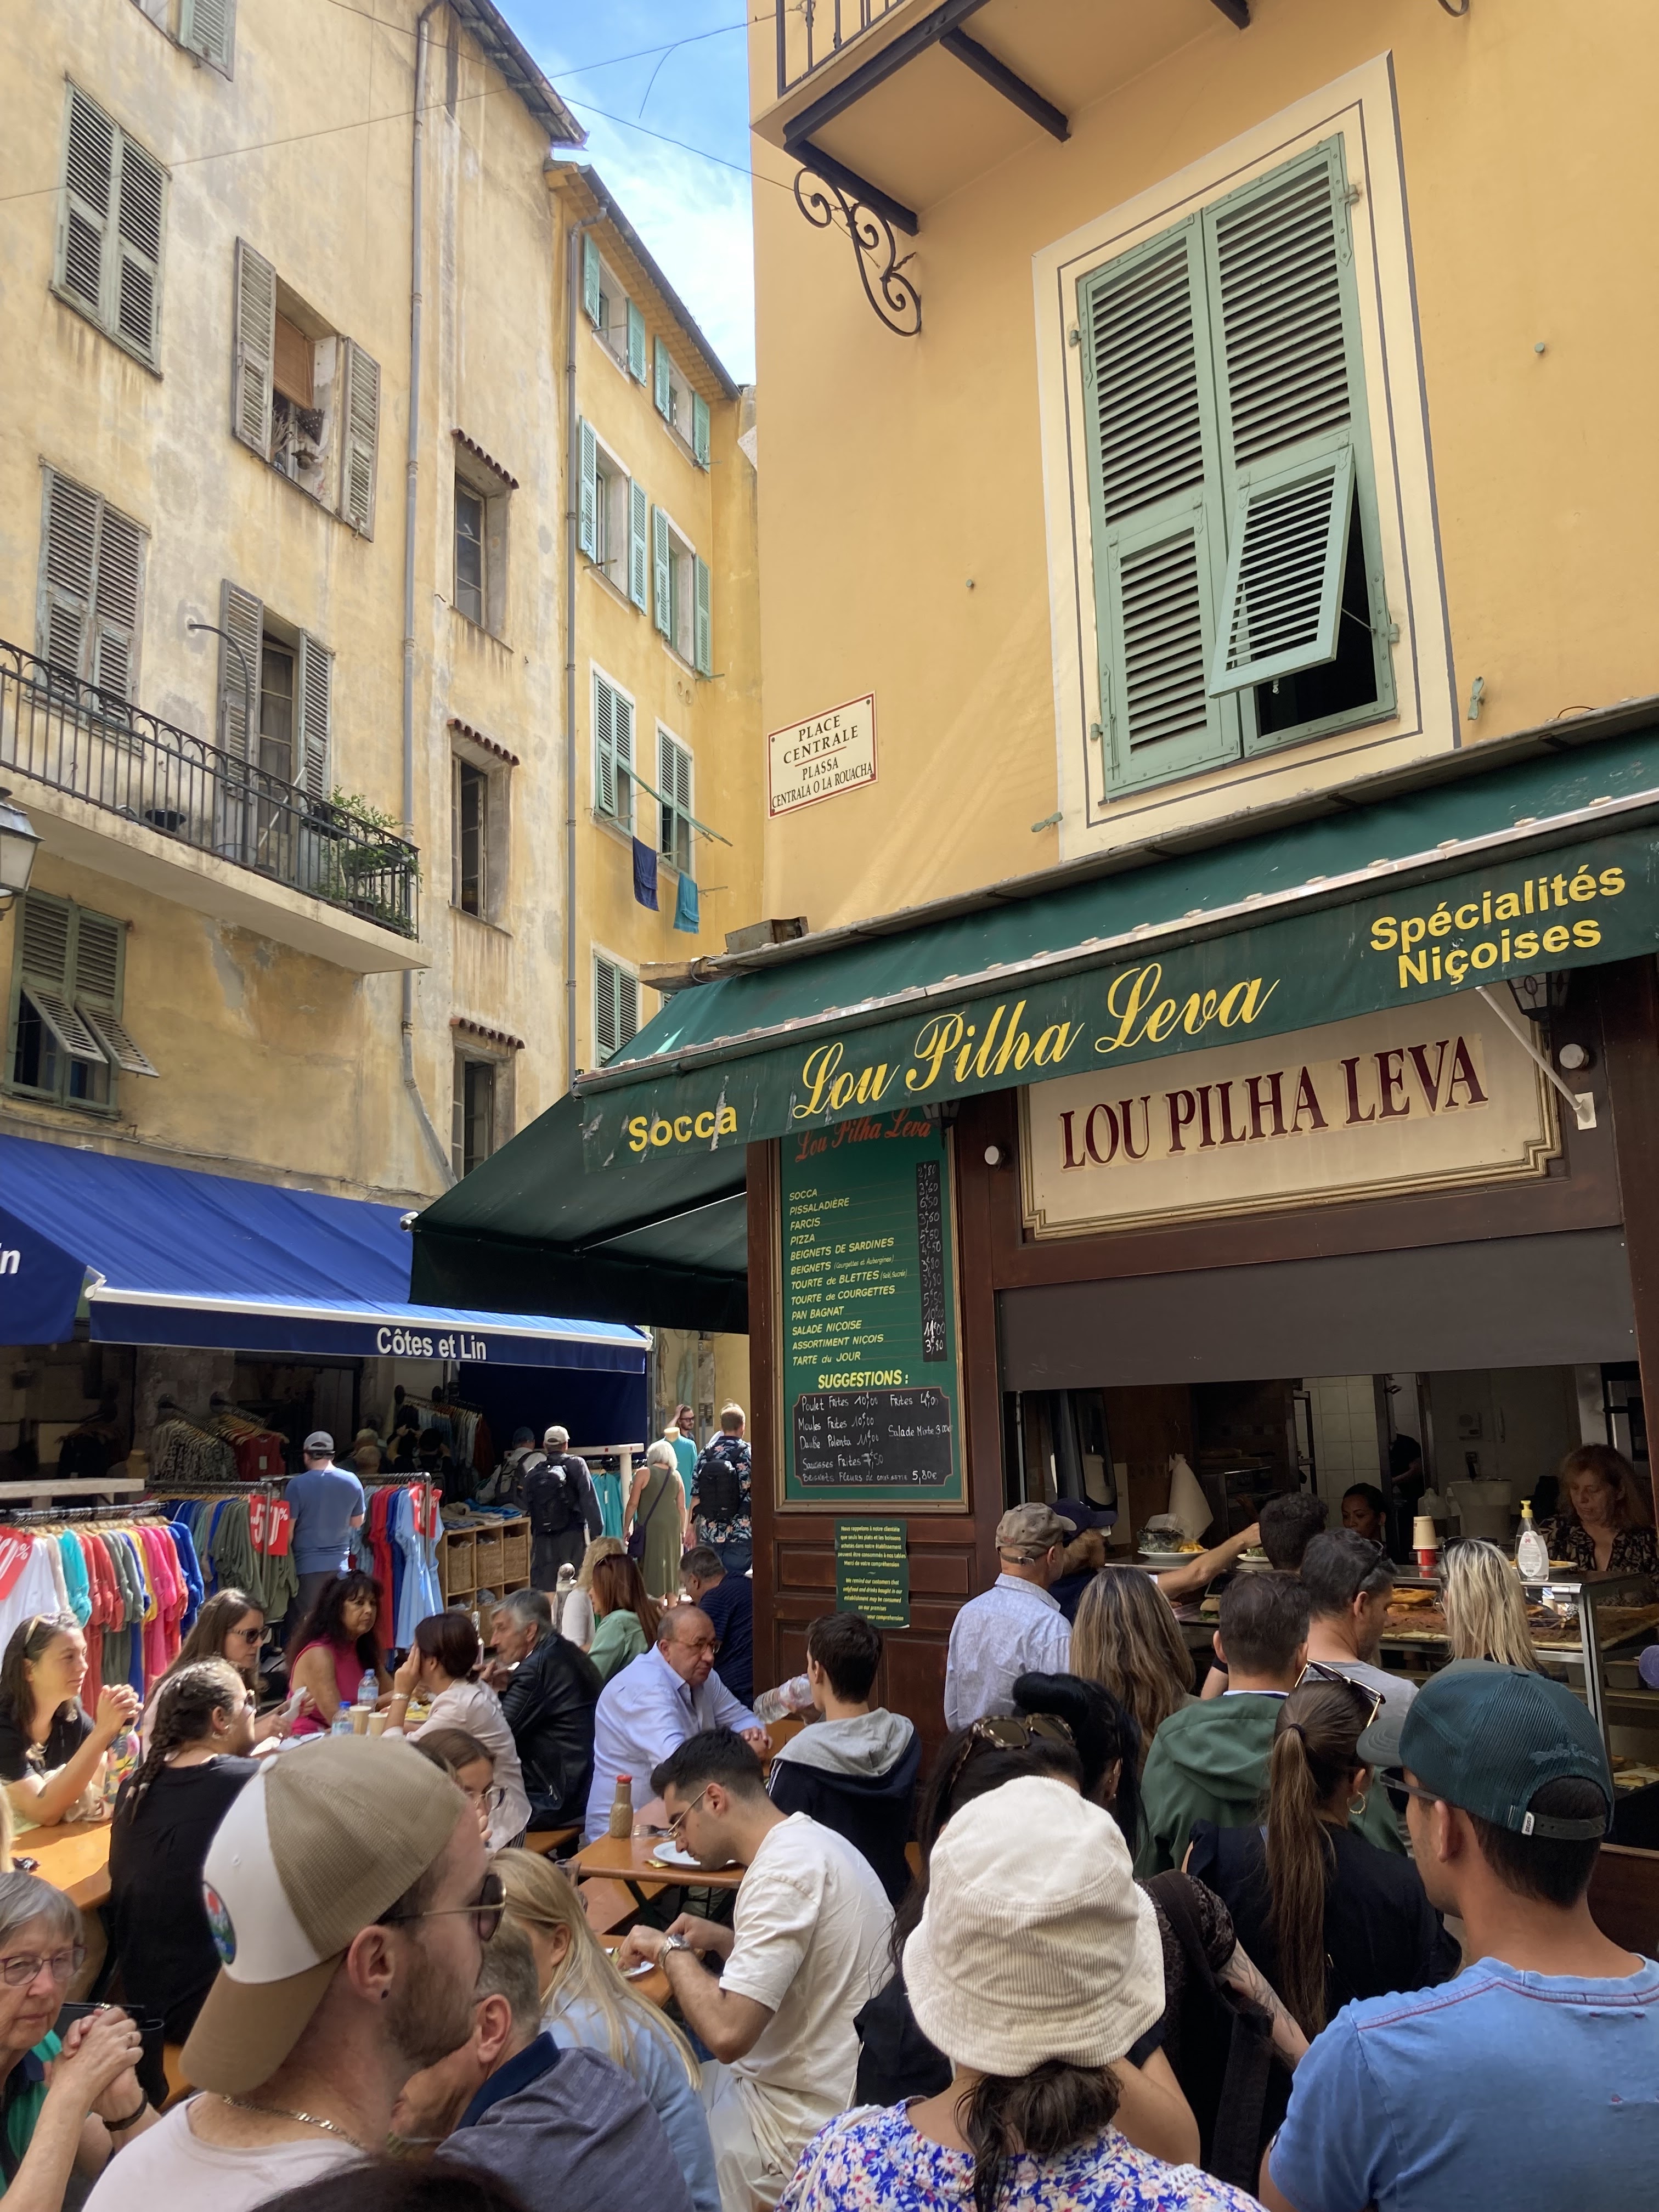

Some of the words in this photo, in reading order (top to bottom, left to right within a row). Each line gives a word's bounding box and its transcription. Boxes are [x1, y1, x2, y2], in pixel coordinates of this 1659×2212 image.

[798, 715, 840, 742] PLACE
[783, 725, 858, 764] CENTRALE
[803, 757, 838, 780] PLASSA
[772, 785, 811, 808] CENTRALA
[814, 781, 819, 793] O
[822, 777, 832, 790] LA
[835, 762, 872, 785] ROUACHA
[1370, 864, 1626, 953] Spécialités
[1398, 919, 1601, 989] Niçoises
[793, 1041, 900, 1119] Lou
[906, 1000, 1085, 1091] Pilha
[1094, 963, 1280, 1053] Leva
[1059, 1095, 1150, 1170] LOU
[1165, 1066, 1328, 1153] PILHA
[1340, 1036, 1488, 1123] LEVA
[629, 1106, 737, 1152] Socca
[795, 1130, 827, 1163] Lou
[884, 1108, 931, 1138] Leva
[789, 1188, 817, 1201] SOCCA
[789, 1197, 850, 1216] PISSALADIÈRE
[790, 1217, 821, 1231] FARCIS
[790, 1233, 815, 1246] PIZZA
[790, 1246, 831, 1261] BEIGNETS
[835, 1244, 847, 1254] DE
[849, 1237, 894, 1252] SARDINES
[791, 1261, 831, 1275] BEIGNETS
[791, 1277, 823, 1290] TOURTE
[826, 1277, 836, 1285] de
[839, 1270, 879, 1284] BLETTES
[791, 1293, 822, 1306] TOURTE
[826, 1293, 836, 1301] de
[838, 1285, 895, 1300] COURGETTES
[792, 1310, 807, 1321] PAN
[810, 1306, 844, 1319] BAGNAT
[792, 1324, 823, 1336] SALADE
[826, 1319, 862, 1333] NIÇOISE
[377, 1327, 433, 1357] Côtes
[439, 1334, 456, 1358] et
[461, 1334, 487, 1361] Lin
[792, 1336, 850, 1350] ASSORTIMENT
[852, 1334, 884, 1346] NIÇOIS
[793, 1355, 817, 1366] TARTE
[821, 1355, 832, 1363] du
[836, 1351, 861, 1362] JOUR
[802, 1396, 825, 1412] Poulet
[798, 1415, 821, 1431] Moules
[888, 1425, 914, 1437] Salade
[917, 1425, 934, 1437] Mixte
[827, 1434, 851, 1448] Polenta
